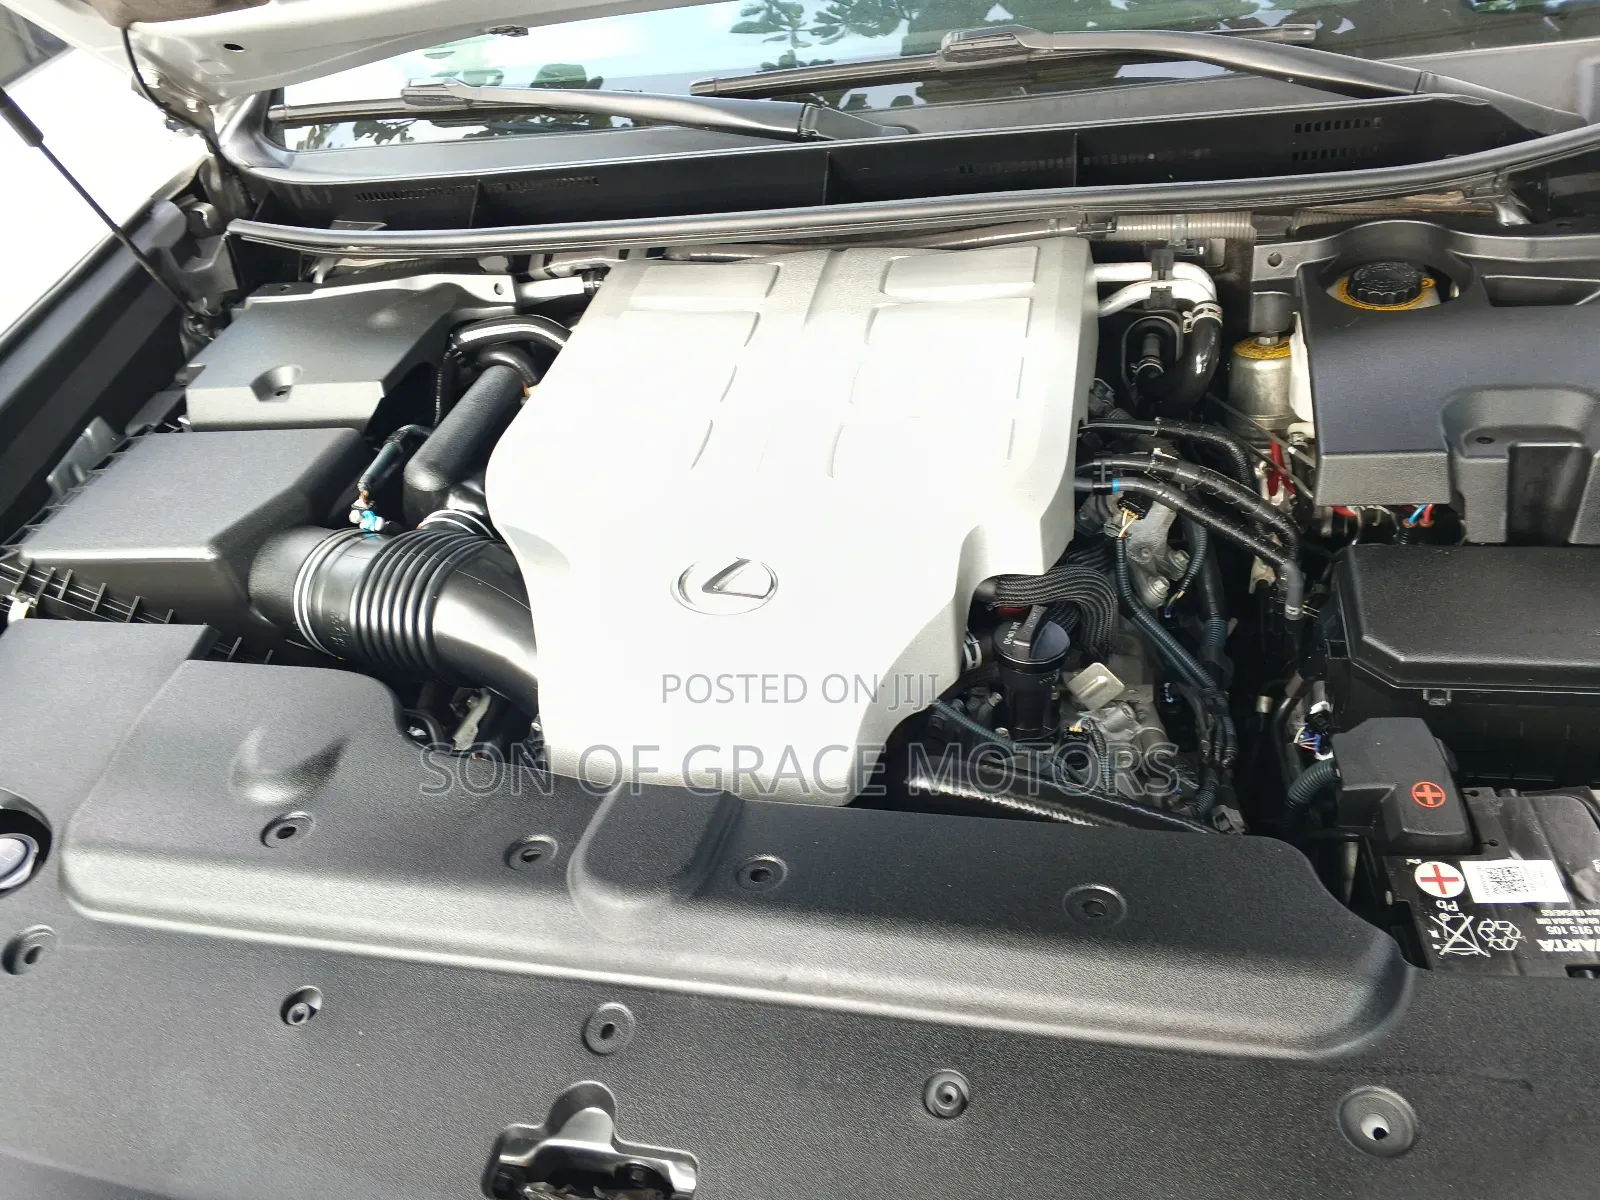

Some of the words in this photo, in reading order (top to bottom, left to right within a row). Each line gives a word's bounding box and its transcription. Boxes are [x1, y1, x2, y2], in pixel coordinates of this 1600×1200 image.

[1436, 900, 1459, 911] Pb
[1545, 925, 1569, 935] 105
[1569, 925, 1594, 935] 915
